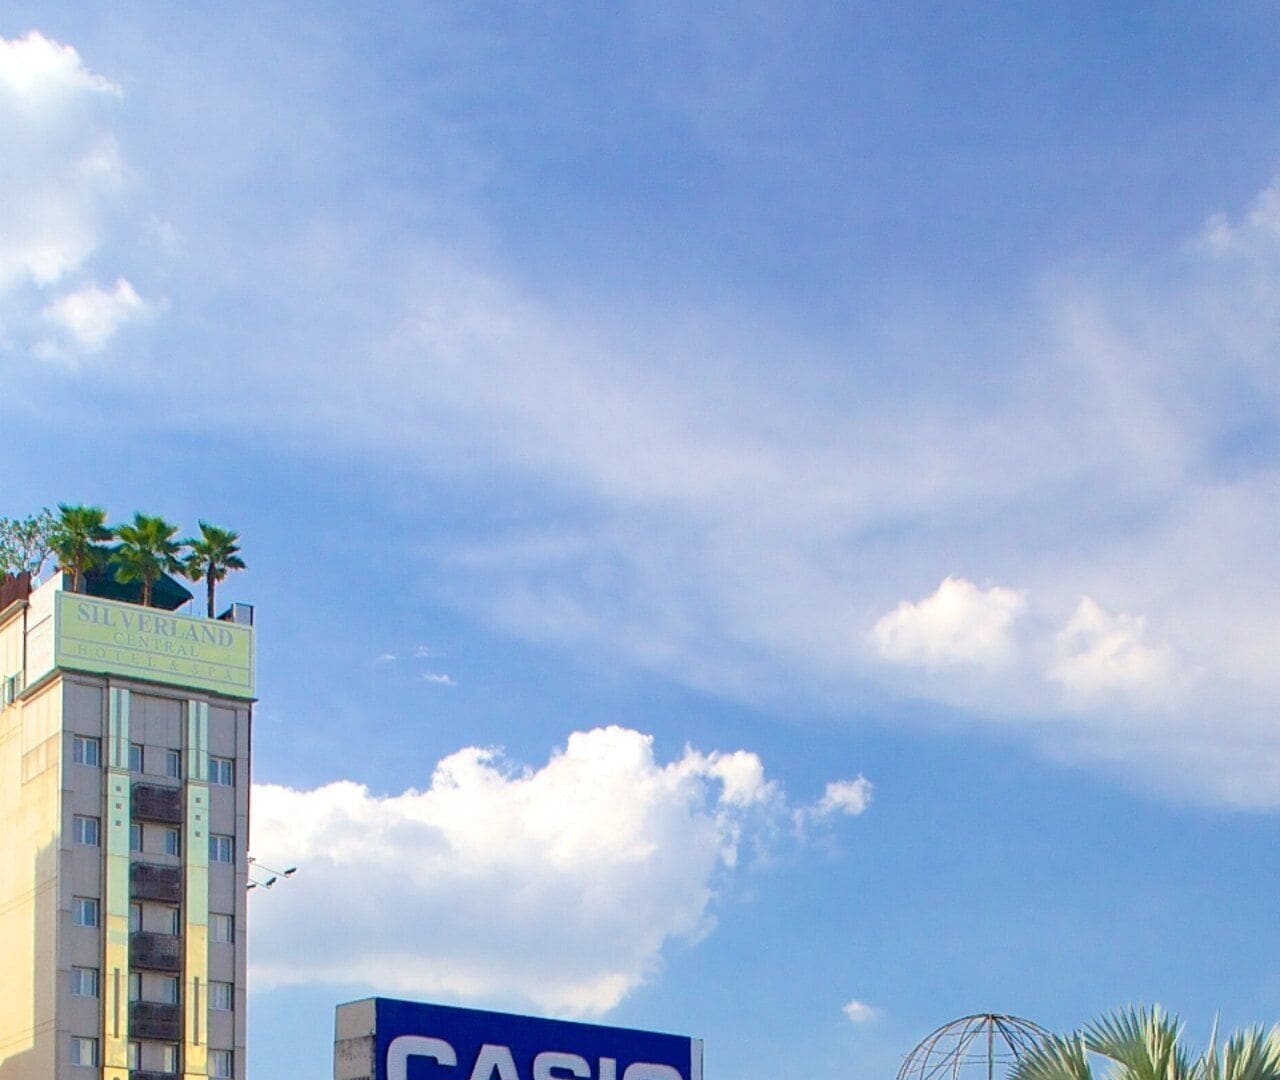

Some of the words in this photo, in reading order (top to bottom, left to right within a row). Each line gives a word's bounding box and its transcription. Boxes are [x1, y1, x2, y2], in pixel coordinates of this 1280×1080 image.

[77, 603, 233, 647] SILVERLAND
[113, 631, 200, 657] CENTRAL
[78, 643, 154, 667] HOTEL
[169, 660, 178, 671] &
[191, 663, 233, 681] SPA
